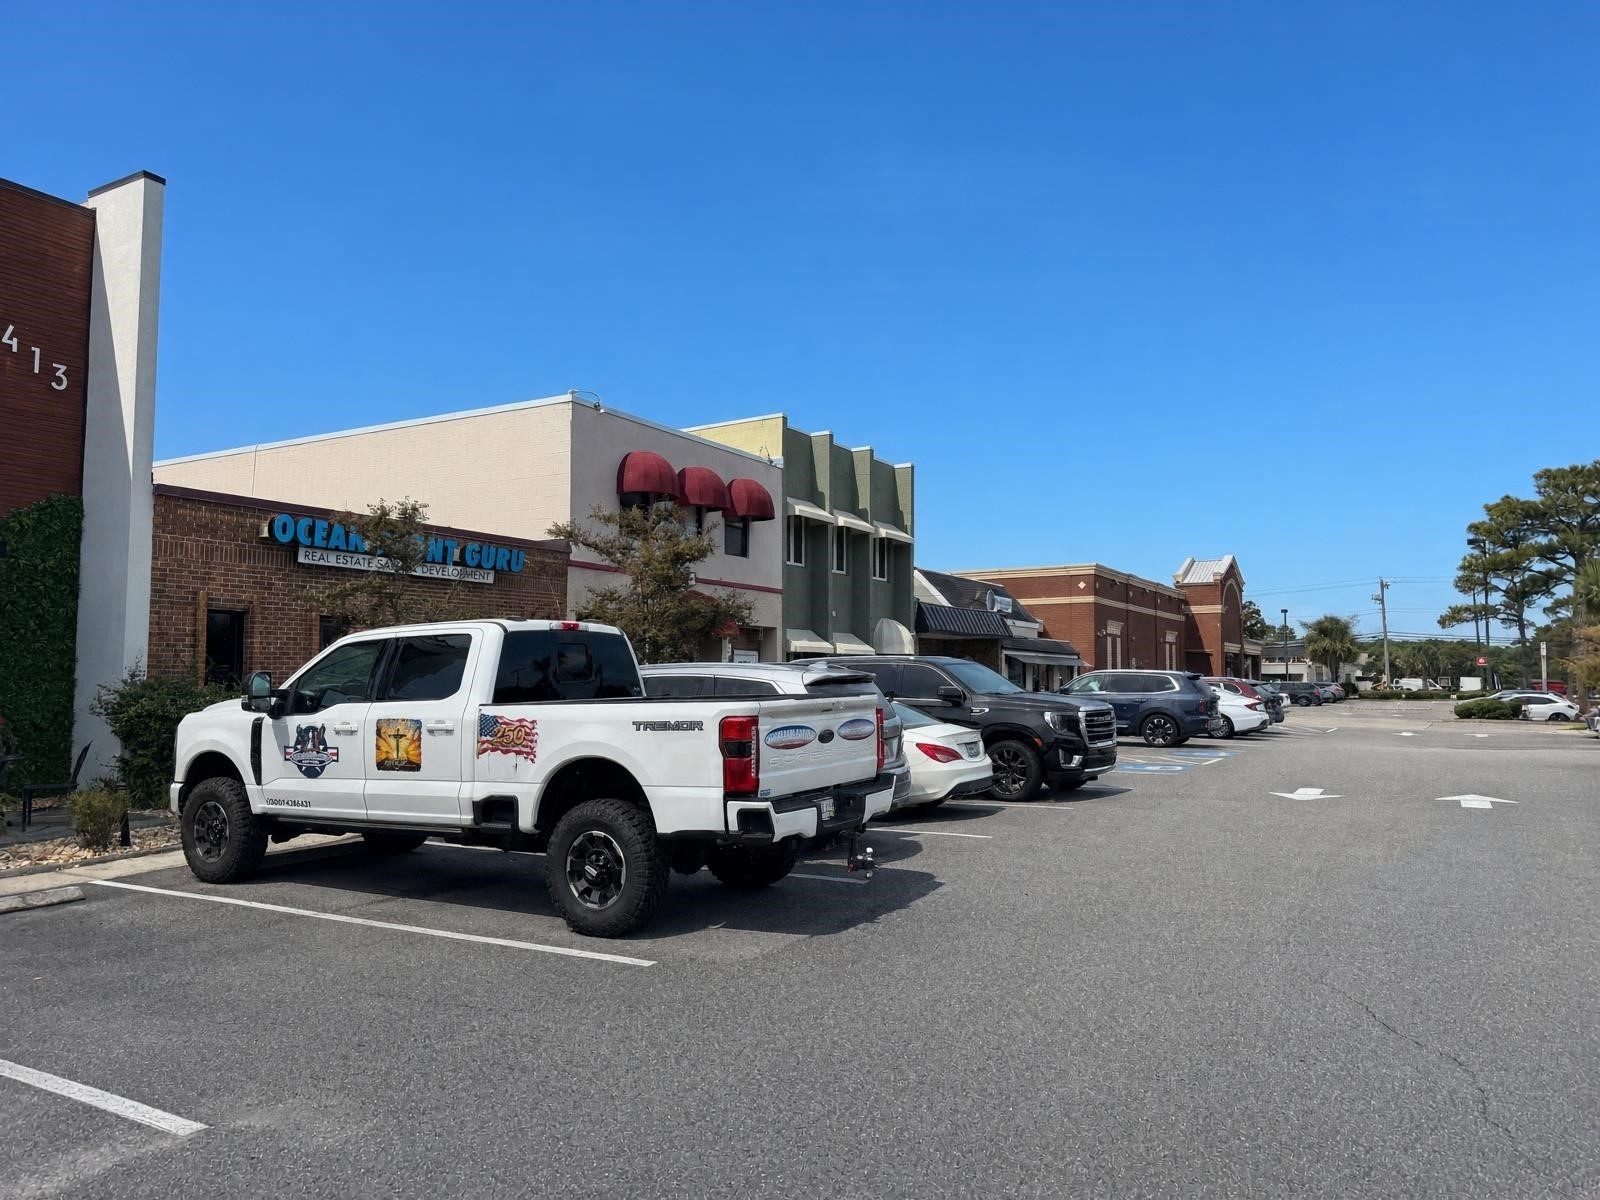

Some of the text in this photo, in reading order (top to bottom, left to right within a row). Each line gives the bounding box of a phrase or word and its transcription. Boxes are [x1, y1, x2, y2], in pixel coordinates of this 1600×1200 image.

[2, 324, 68, 391] 413
[273, 513, 367, 553] OCEAN
[465, 543, 525, 573] GURU
[304, 550, 330, 564] REAL
[336, 554, 374, 569] ESTATE
[491, 725, 525, 746] 250
[632, 720, 704, 732] TREMOR
